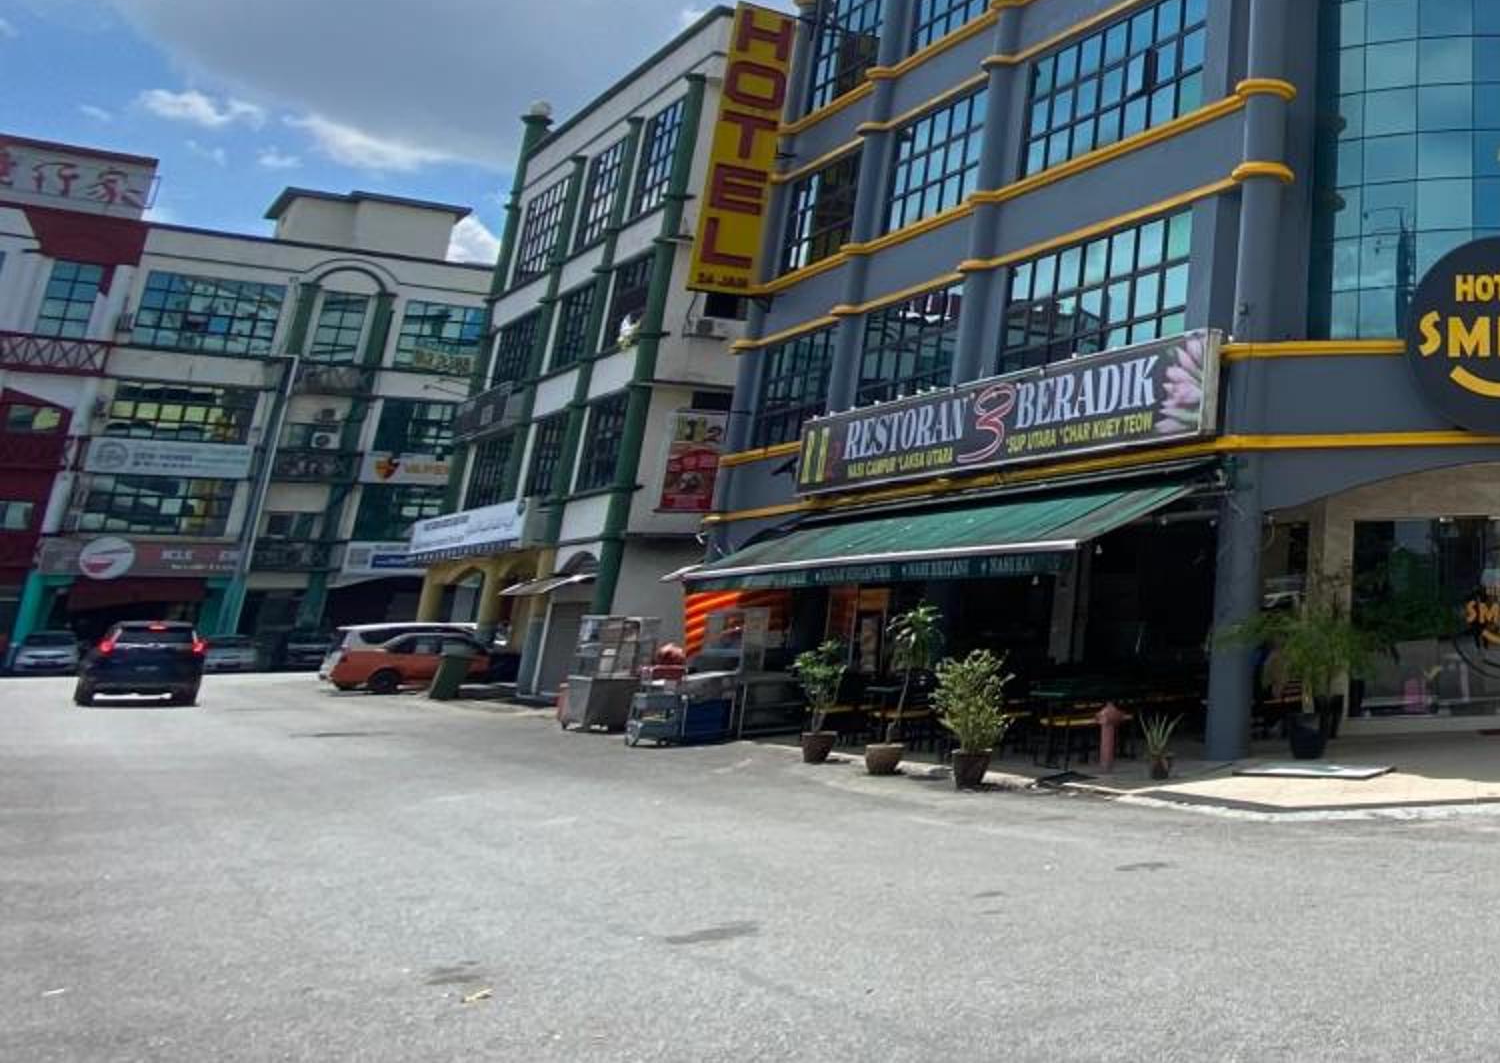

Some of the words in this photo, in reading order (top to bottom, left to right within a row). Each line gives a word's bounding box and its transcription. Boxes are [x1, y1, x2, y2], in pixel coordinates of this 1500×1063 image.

[700, 8, 796, 270] HOTEL
[842, 397, 968, 461] RESTORAN
[1015, 355, 1158, 430] BERADIK
